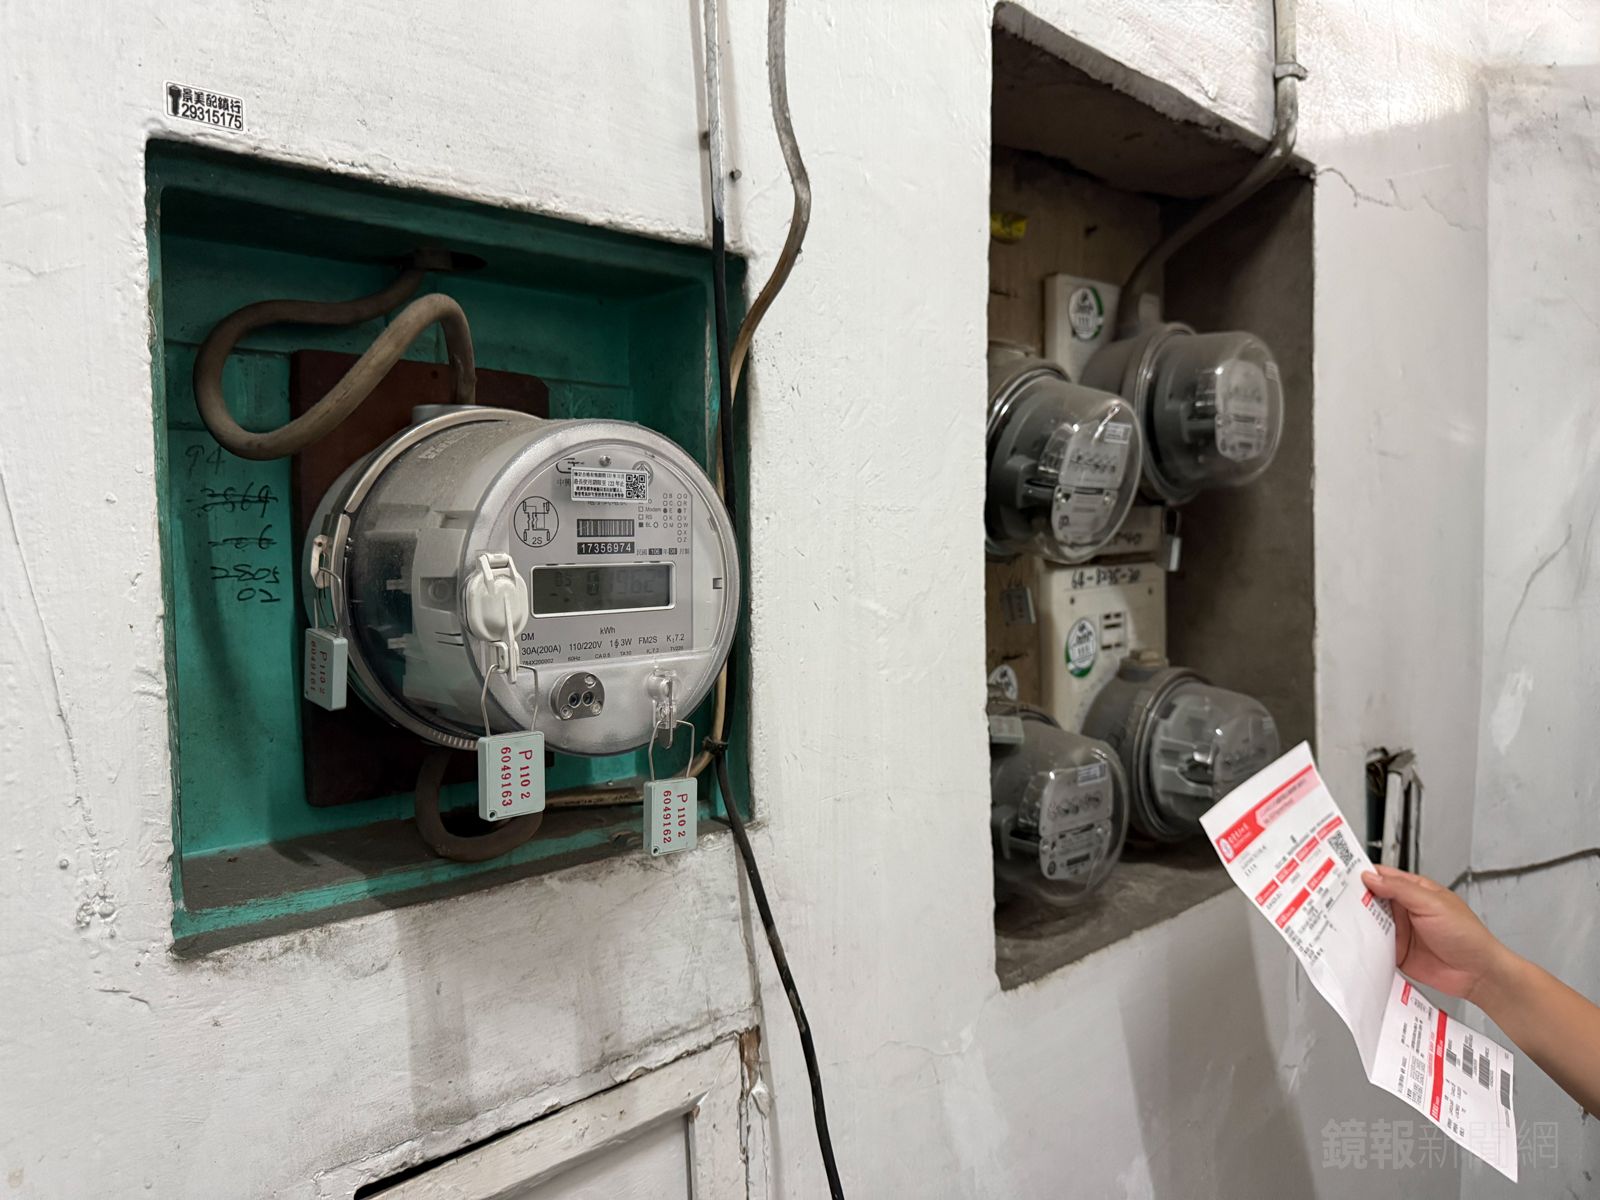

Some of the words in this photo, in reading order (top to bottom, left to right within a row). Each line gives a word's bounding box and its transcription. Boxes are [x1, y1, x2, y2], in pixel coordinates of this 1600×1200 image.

[182, 103, 241, 129] 29315175
[531, 536, 543, 545] 2S
[580, 542, 632, 553] 17356974
[521, 633, 534, 641] DM
[600, 626, 615, 635] kWh
[521, 644, 561, 656] 30A(200A)
[569, 641, 602, 651] 110/220V
[638, 635, 658, 644] FM2S
[500, 746, 513, 807] 6049163
[663, 790, 672, 844] 6049162
